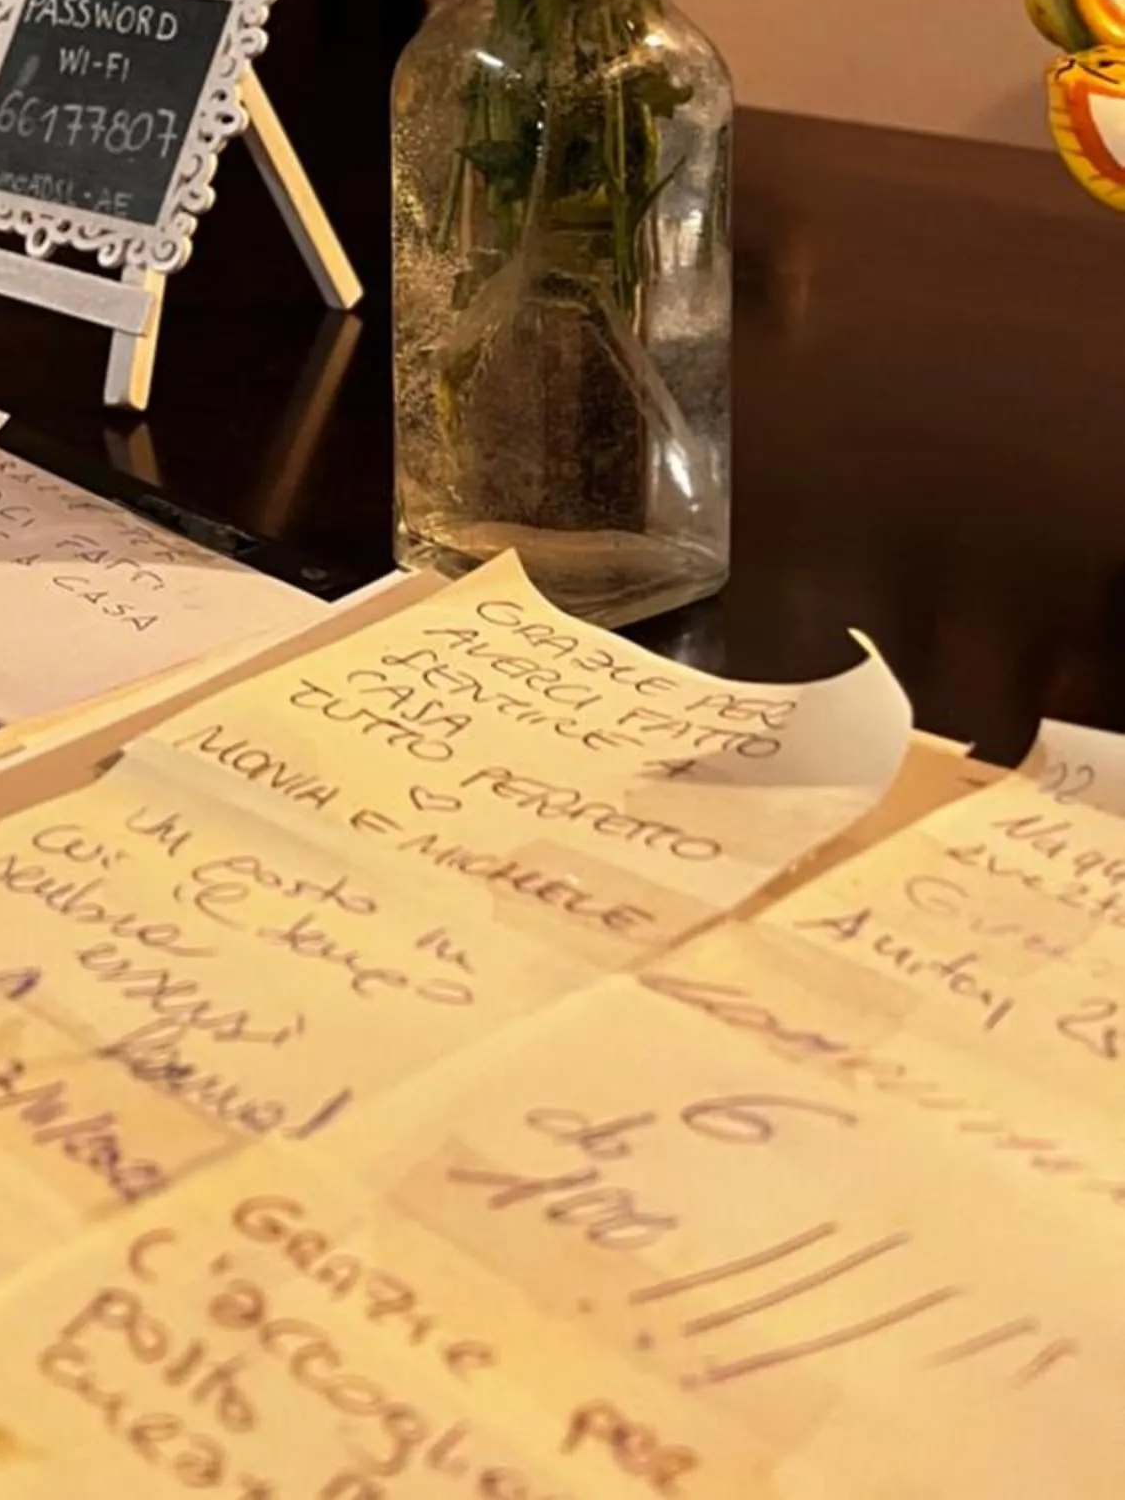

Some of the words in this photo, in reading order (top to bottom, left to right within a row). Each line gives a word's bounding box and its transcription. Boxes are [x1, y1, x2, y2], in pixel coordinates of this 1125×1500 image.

[58, 46, 131, 83] WI-FI
[52, 574, 159, 632] CASA
[347, 669, 474, 740] CASA
[381, 648, 645, 754] SENTIRE
[424, 626, 605, 714] AVERCI
[616, 705, 784, 760] FATTO
[475, 599, 682, 697] GRAZIE
[684, 689, 798, 732] PER
[288, 679, 456, 765] TUTTO
[459, 766, 724, 863] PERFETTO
[349, 808, 407, 834] E
[397, 835, 662, 930] MICHELE
